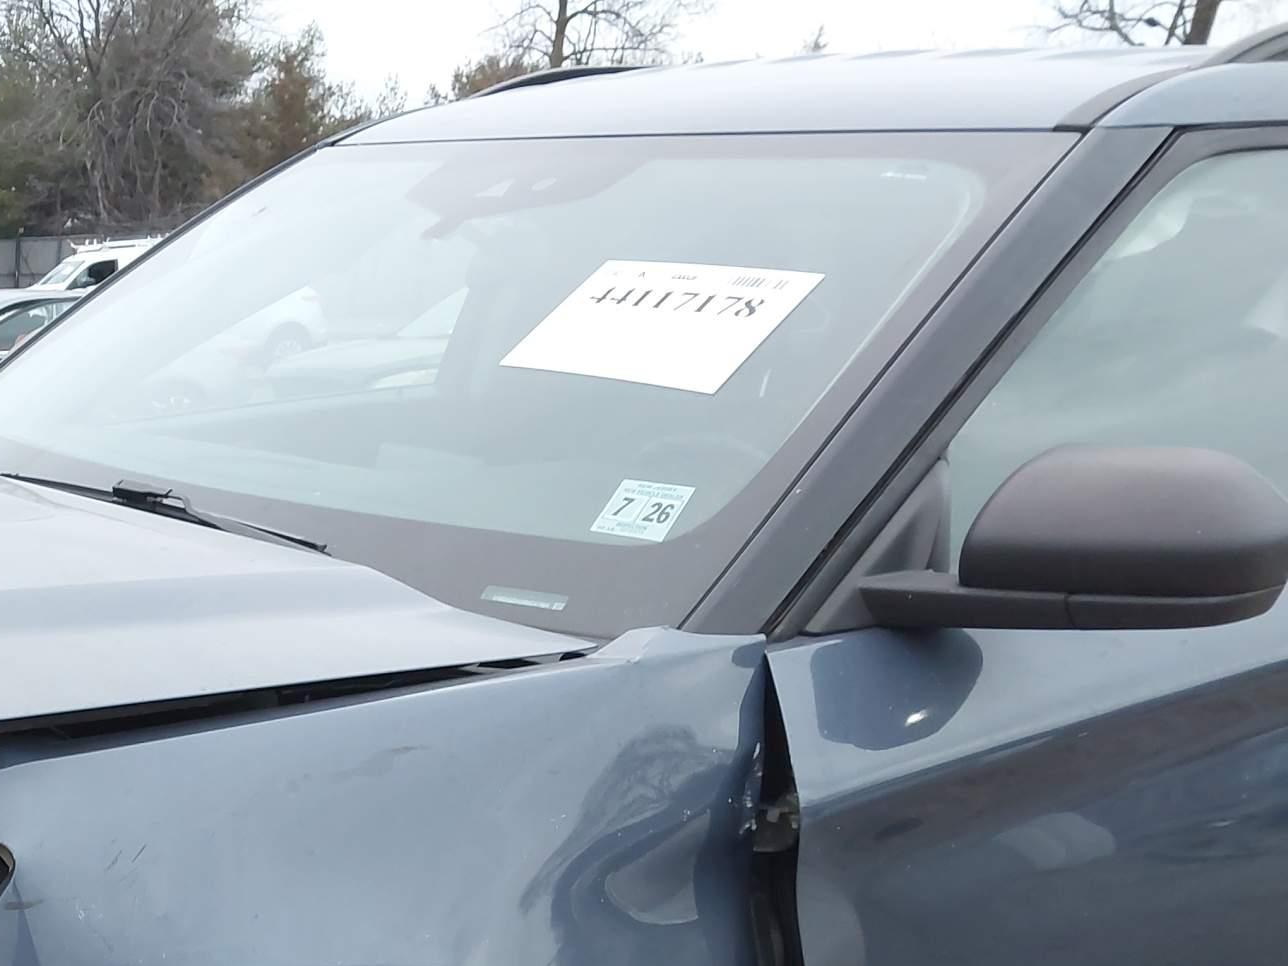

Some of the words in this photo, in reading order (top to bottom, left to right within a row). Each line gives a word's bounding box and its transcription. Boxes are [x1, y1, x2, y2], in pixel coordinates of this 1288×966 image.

[589, 286, 765, 318] 44117178
[612, 497, 635, 516] 7
[642, 502, 675, 524] 26
